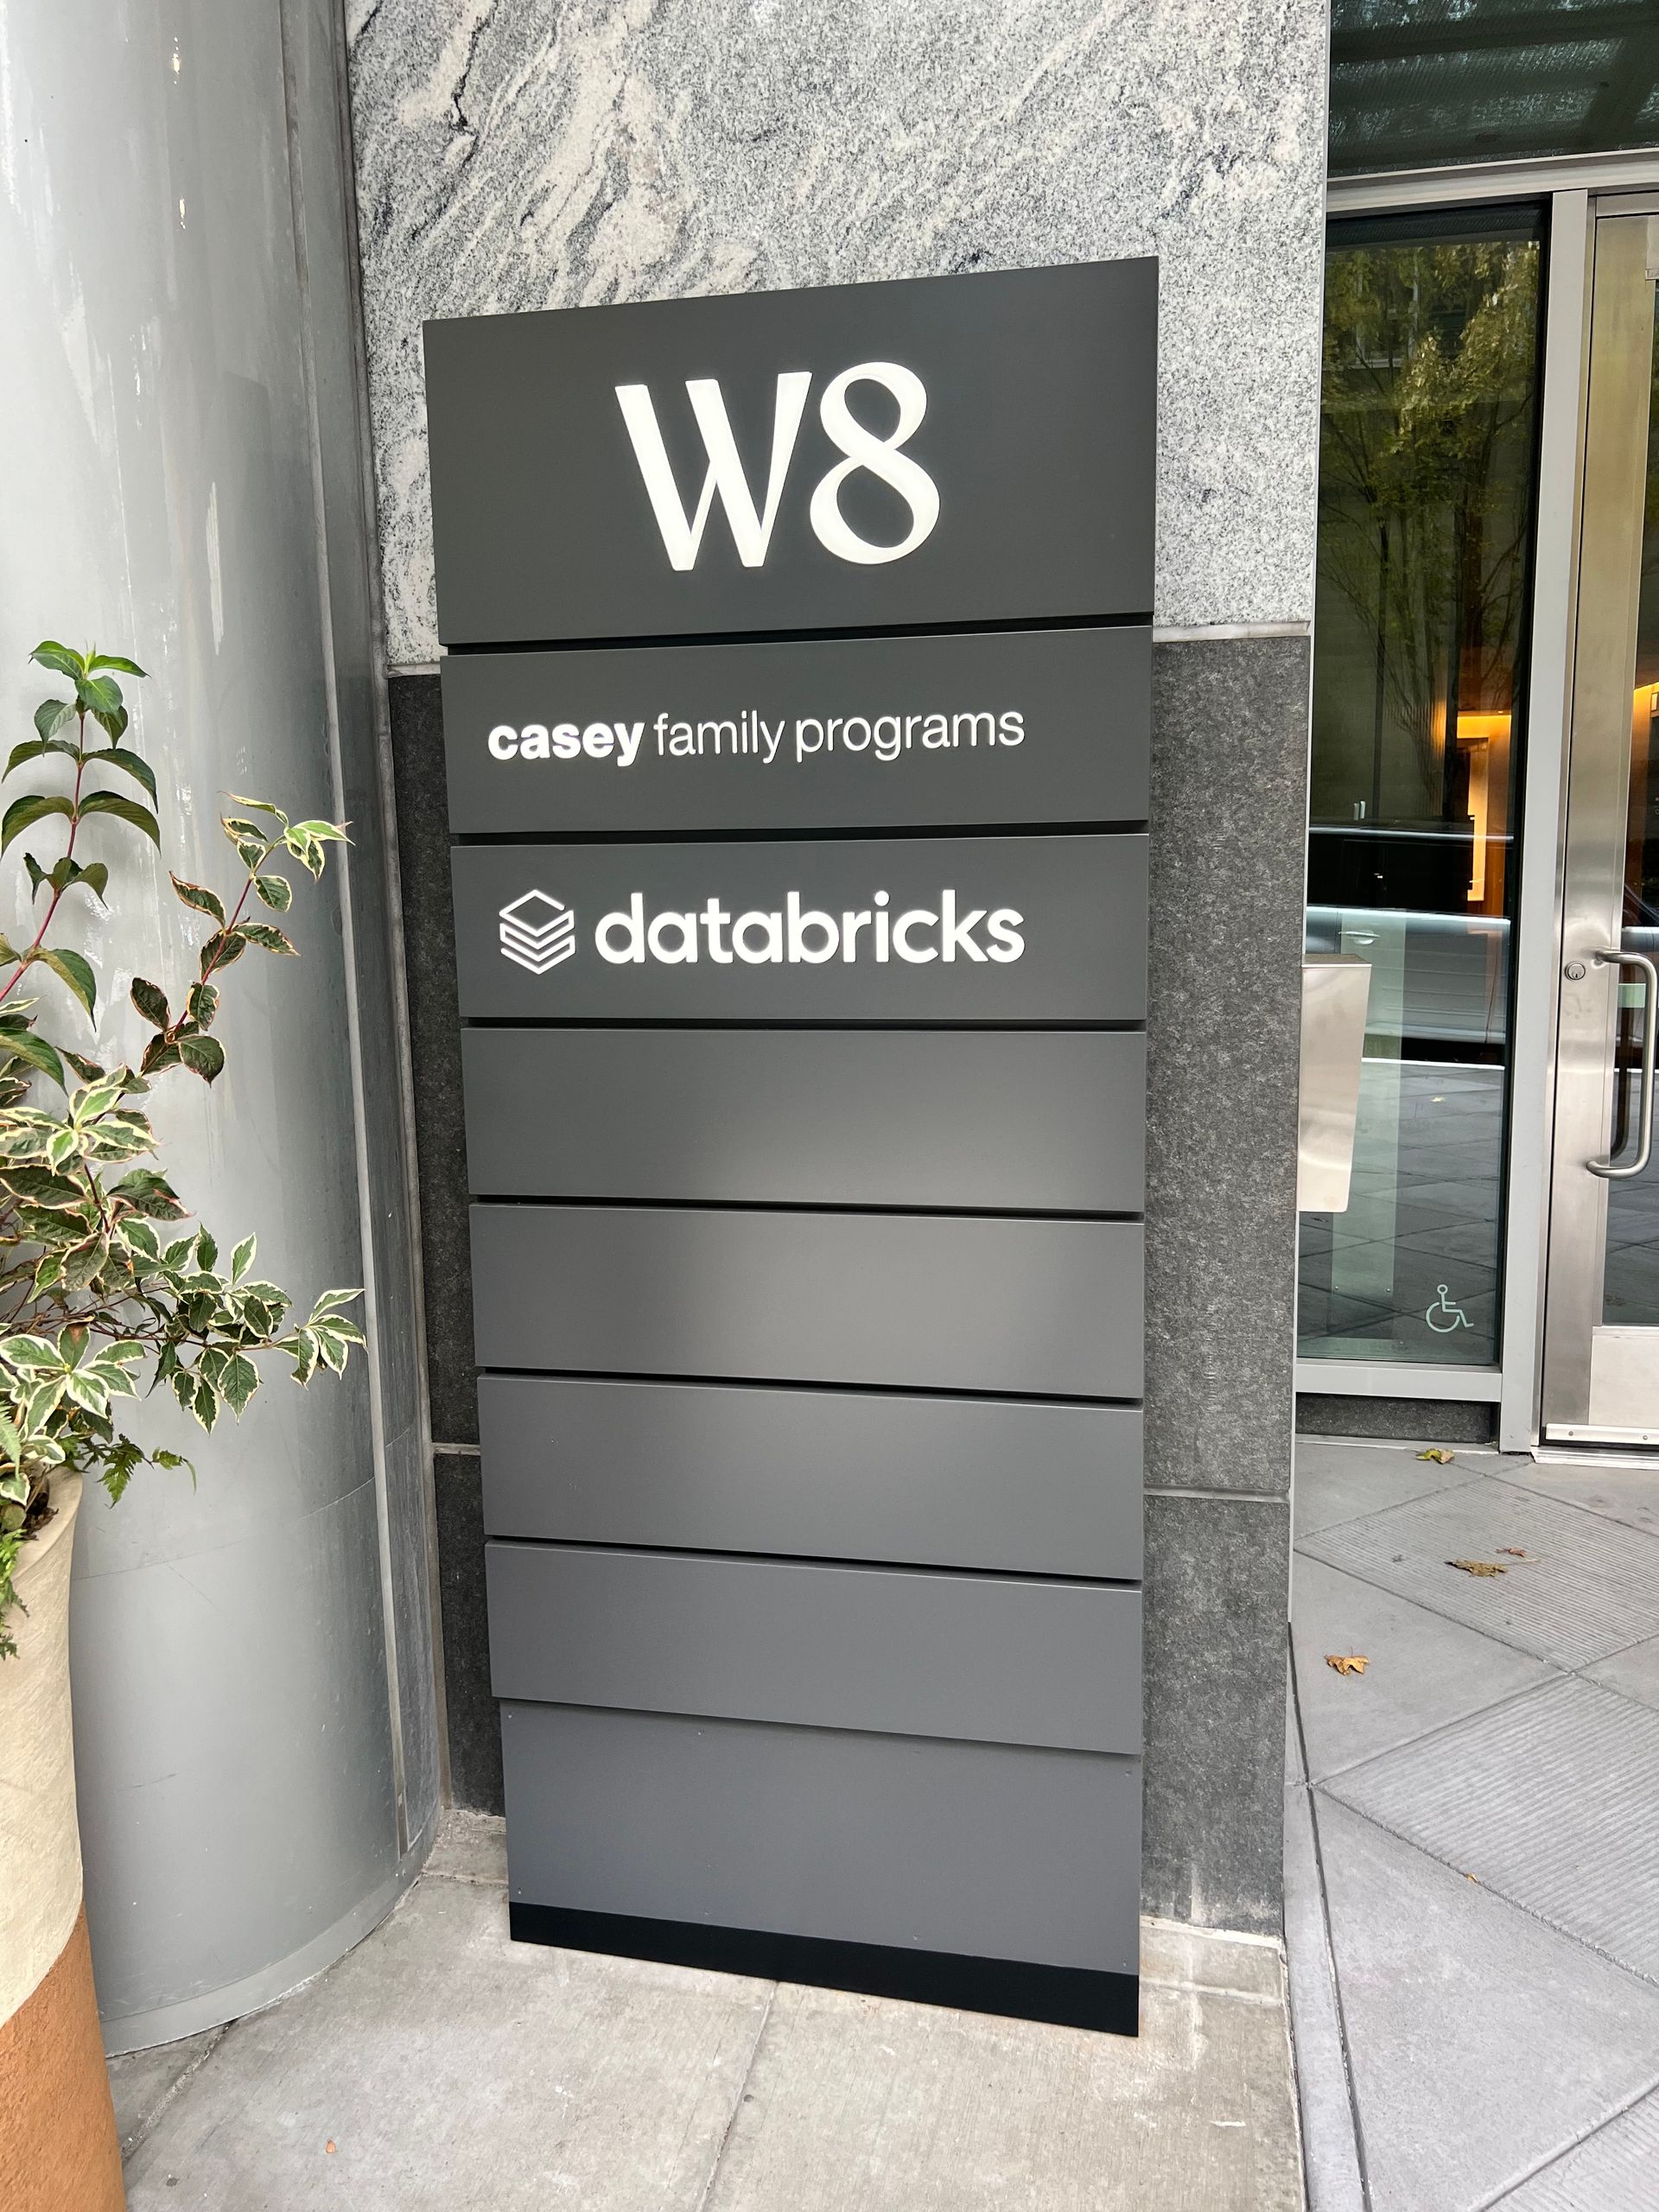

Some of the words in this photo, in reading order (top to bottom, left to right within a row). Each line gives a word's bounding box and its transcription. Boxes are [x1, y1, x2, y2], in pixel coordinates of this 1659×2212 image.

[614, 361, 940, 571] W8
[487, 721, 646, 767] casey
[652, 709, 786, 764] family
[795, 709, 1026, 763] programs
[594, 888, 1026, 965] databricks
